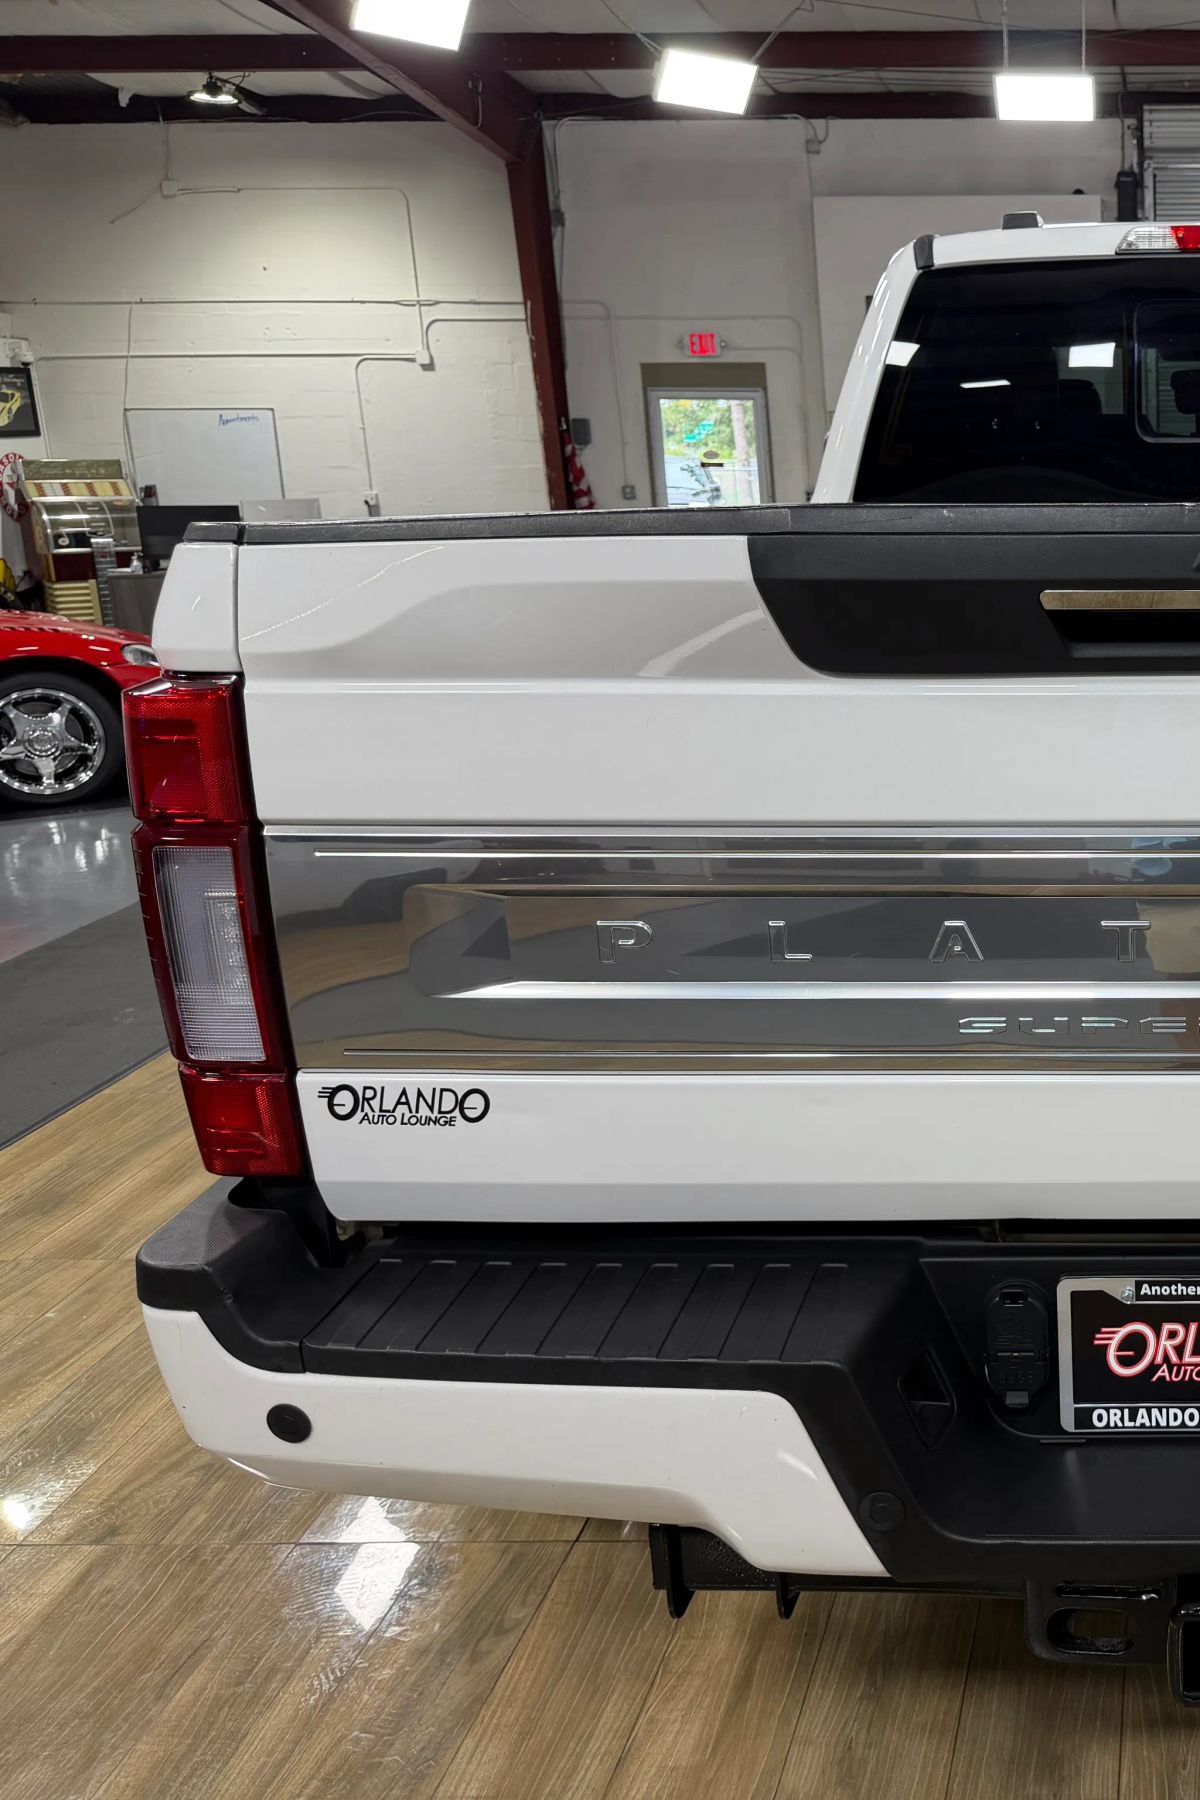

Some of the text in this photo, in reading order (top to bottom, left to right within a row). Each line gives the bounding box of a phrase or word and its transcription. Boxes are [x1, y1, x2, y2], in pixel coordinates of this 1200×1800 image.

[689, 333, 716, 355] EXIT
[318, 1084, 491, 1124] ORLANDO
[358, 1112, 457, 1127] AUTO LOUNGE
[1091, 1407, 1200, 1429] ORLANDO
